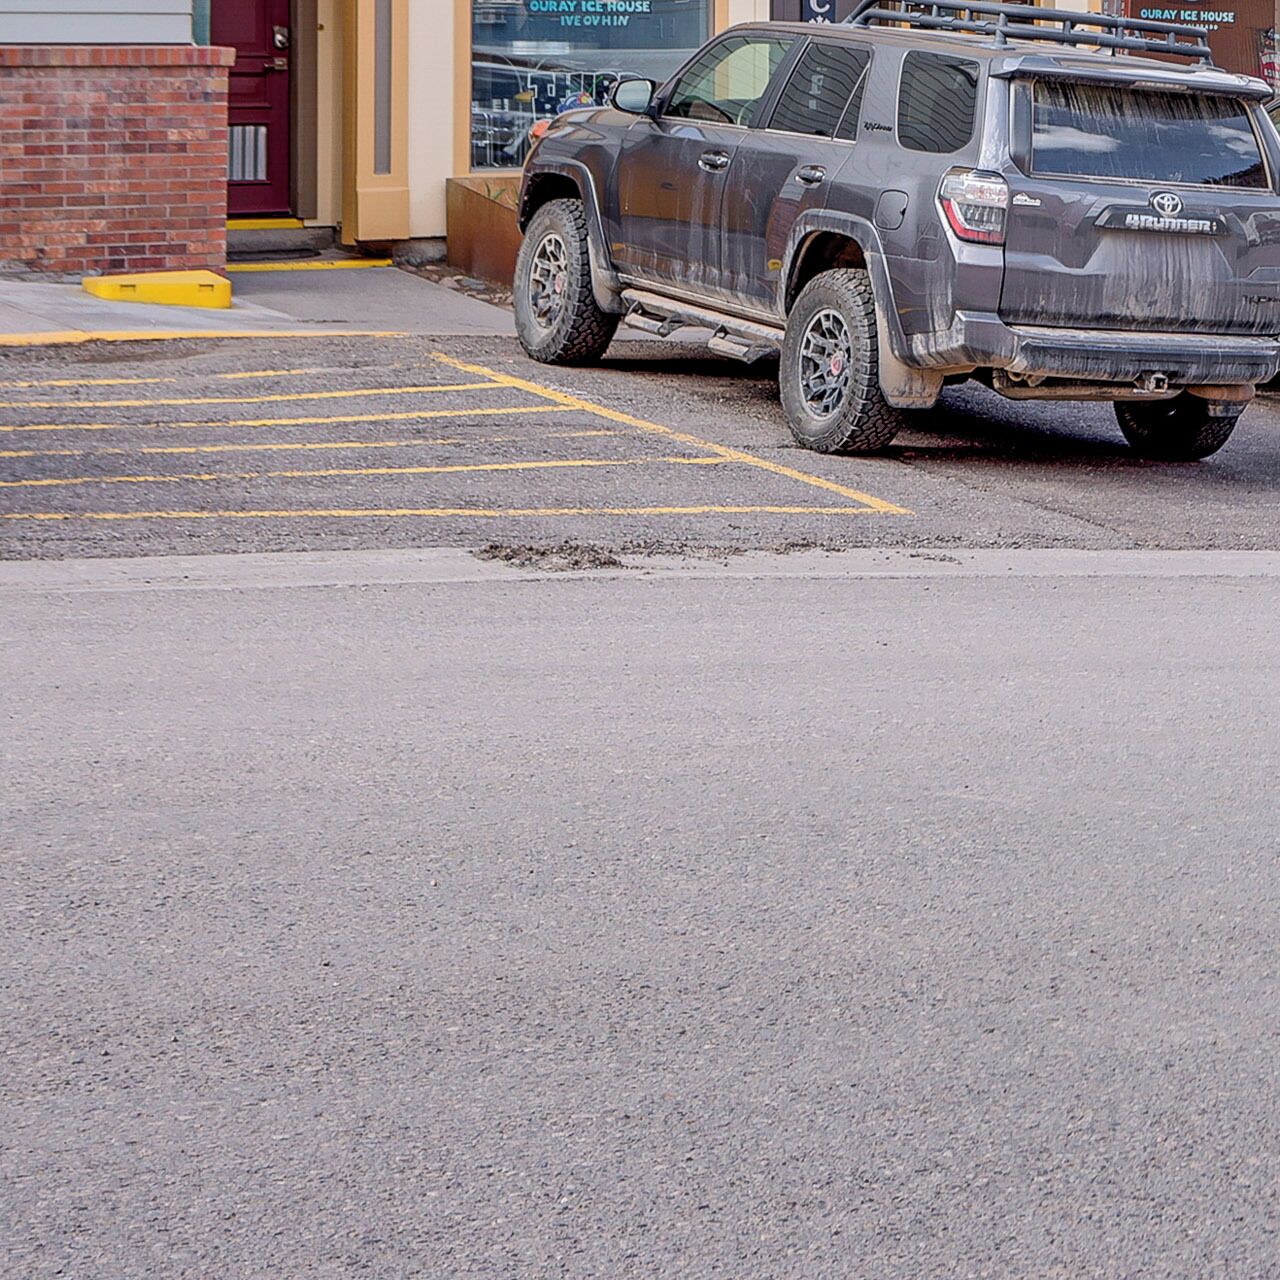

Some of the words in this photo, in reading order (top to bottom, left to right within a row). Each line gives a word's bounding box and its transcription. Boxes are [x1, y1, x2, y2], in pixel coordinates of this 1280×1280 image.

[529, 0, 577, 12] OURAY
[581, 1, 603, 12] ICE
[607, 1, 651, 13] HOUSE
[1140, 8, 1177, 20] OURAY
[1180, 10, 1198, 20] ICE
[1200, 11, 1234, 23] HOUSE
[1125, 214, 1211, 232] 4RUNNER
